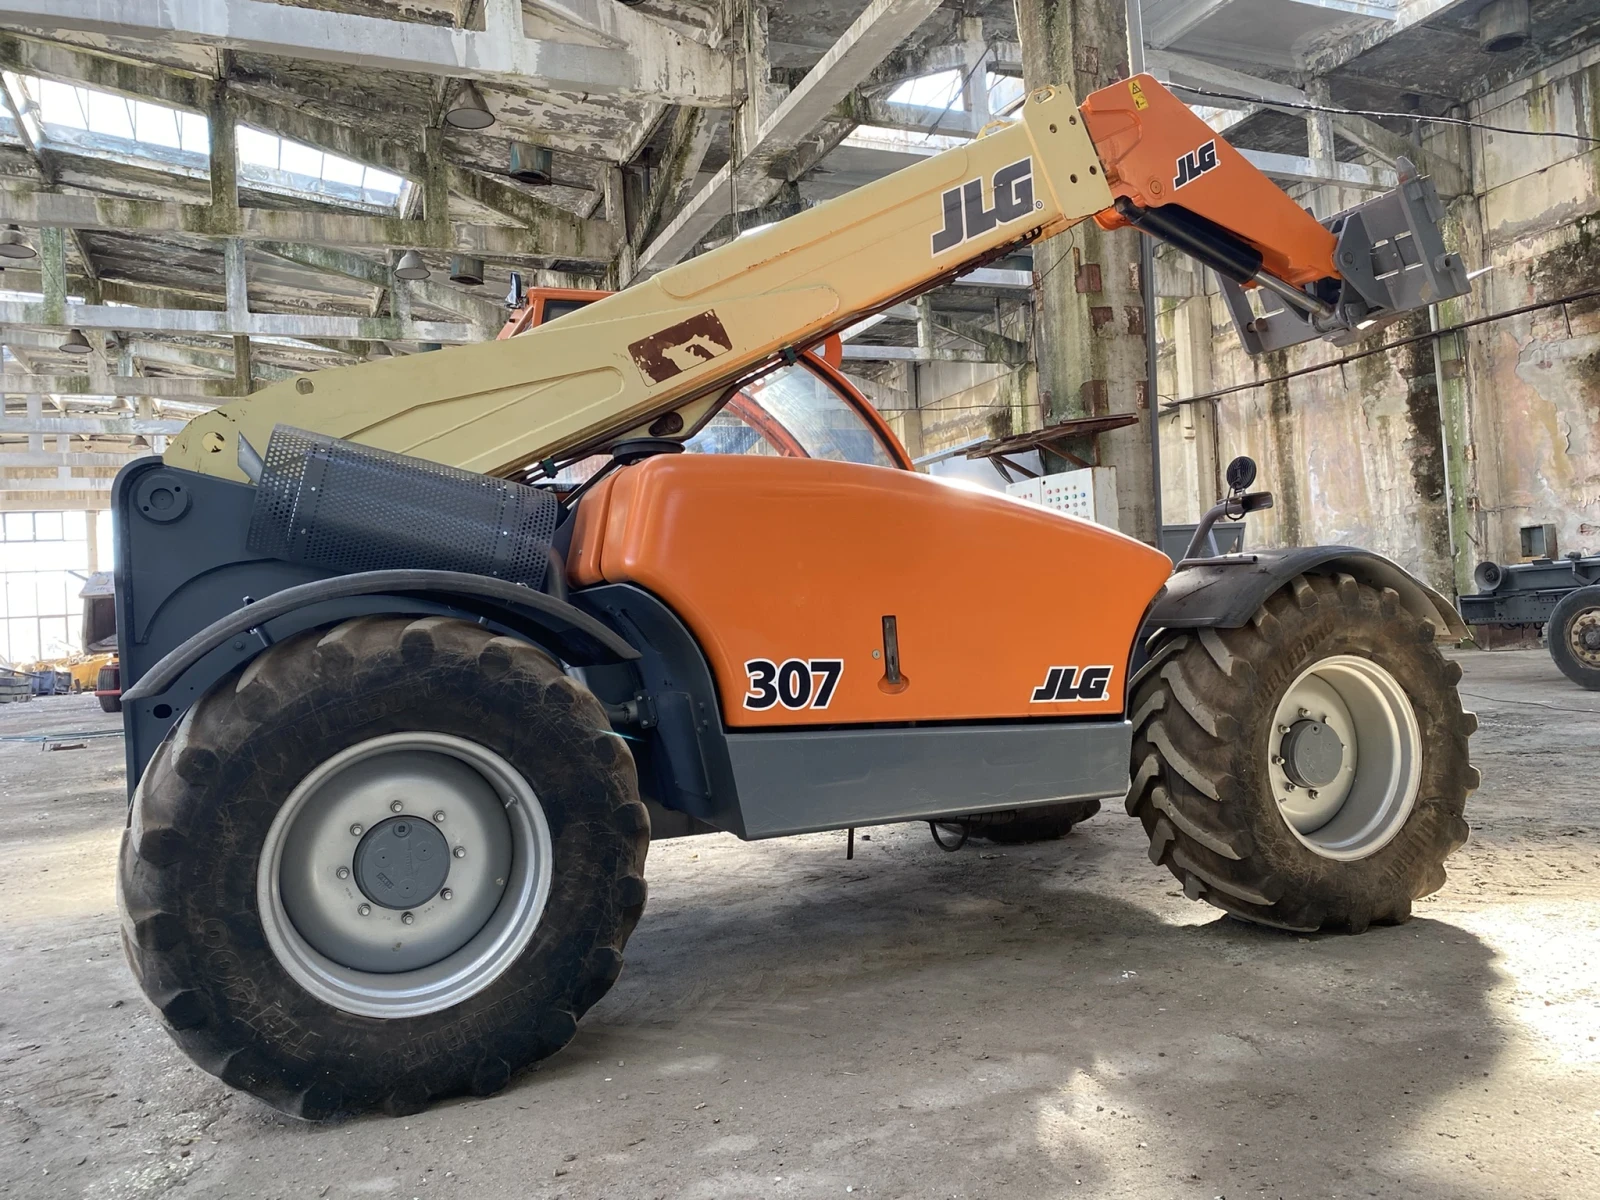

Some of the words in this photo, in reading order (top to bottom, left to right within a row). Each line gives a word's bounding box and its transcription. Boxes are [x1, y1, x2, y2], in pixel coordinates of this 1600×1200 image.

[1174, 140, 1217, 190] JLG
[931, 157, 1034, 257] JLG
[743, 658, 844, 710] 307
[1030, 665, 1114, 703] JLG
